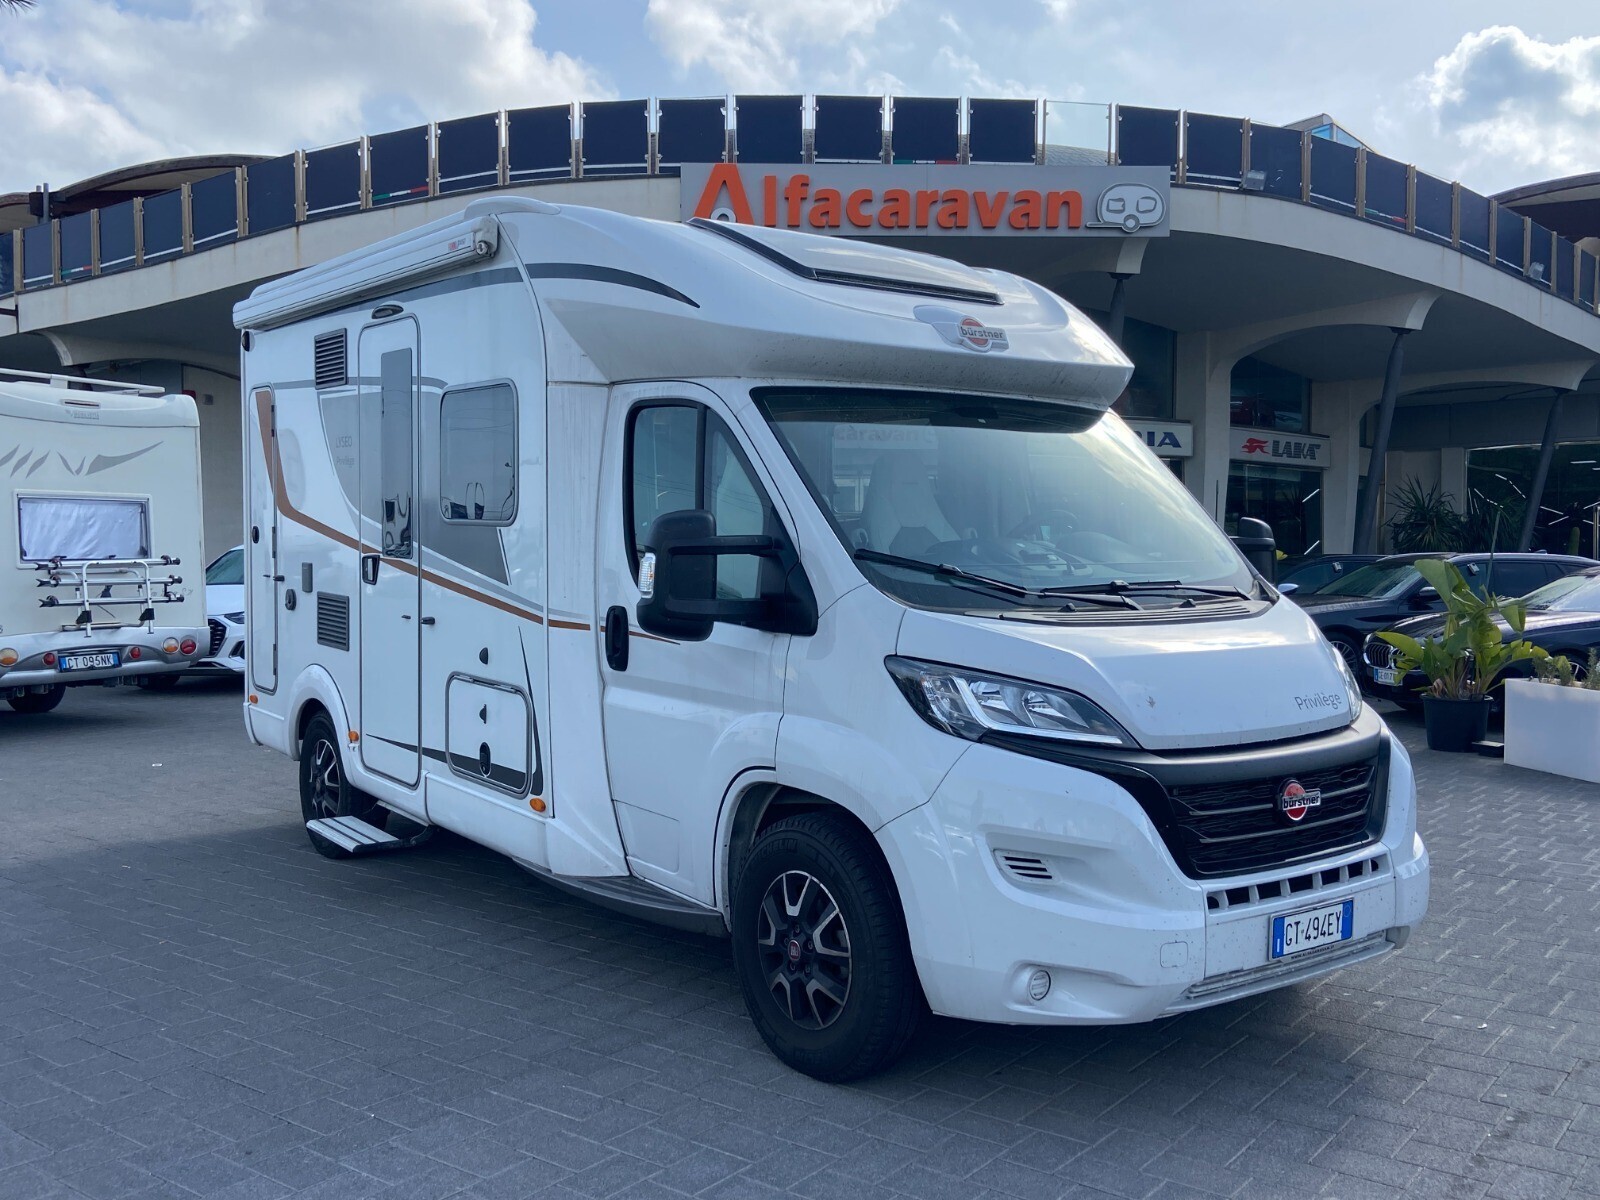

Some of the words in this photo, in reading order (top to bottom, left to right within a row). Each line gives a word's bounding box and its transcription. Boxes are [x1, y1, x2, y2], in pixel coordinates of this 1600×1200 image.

[693, 163, 1083, 229] Alfacaravan
[960, 326, 1004, 339] bürstner
[1271, 439, 1322, 460] LAIKA
[1294, 691, 1342, 710] Privilège
[1283, 793, 1320, 809] bürstner
[1285, 920, 1301, 947] GT
[1304, 910, 1342, 941] 494EY
